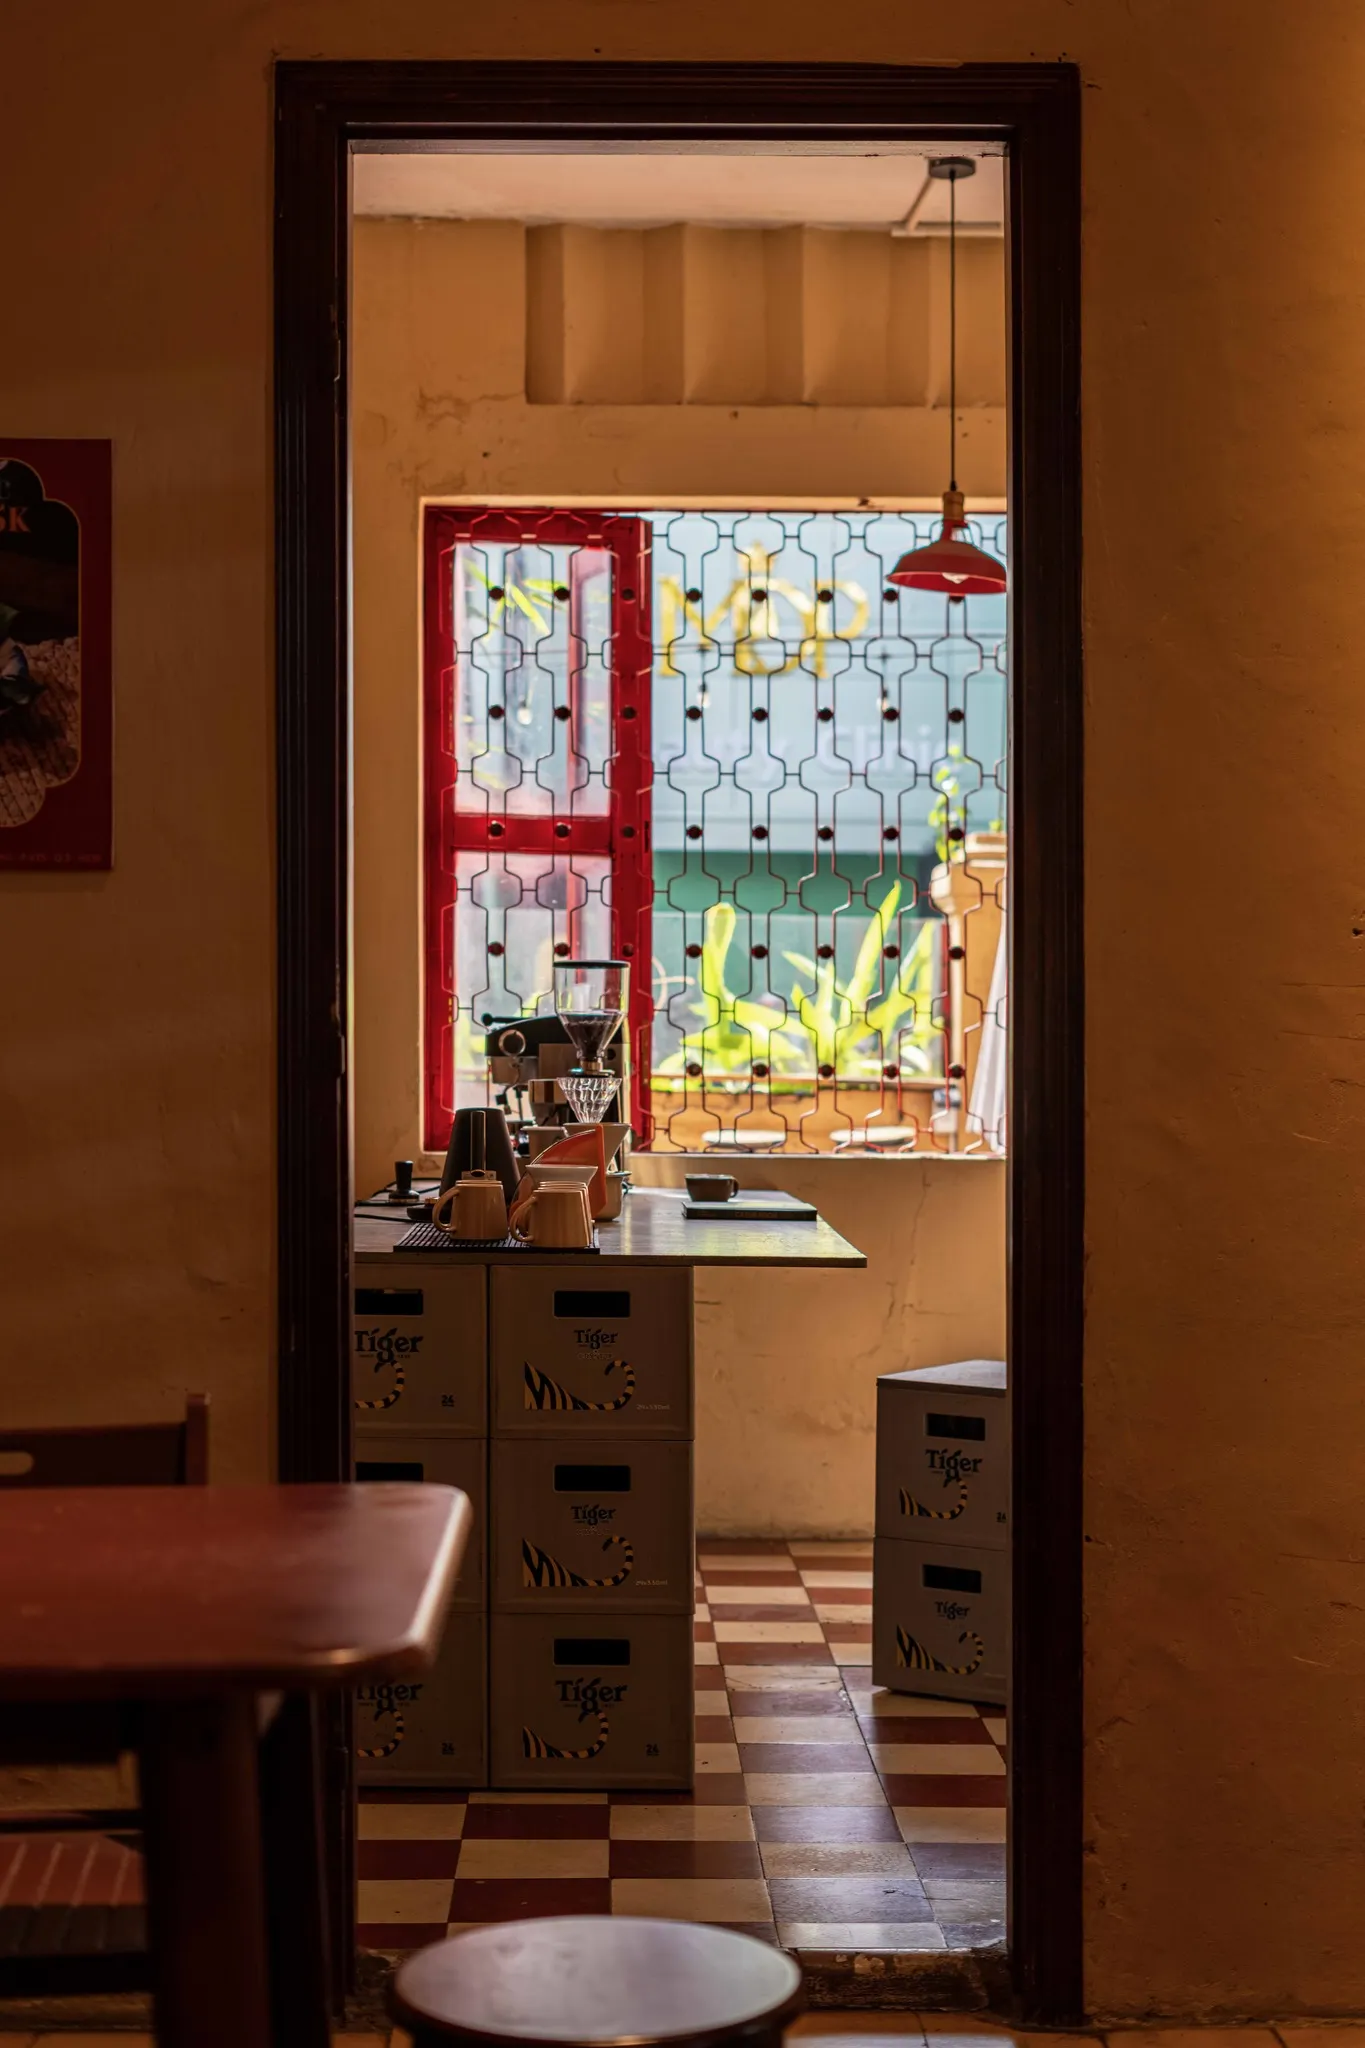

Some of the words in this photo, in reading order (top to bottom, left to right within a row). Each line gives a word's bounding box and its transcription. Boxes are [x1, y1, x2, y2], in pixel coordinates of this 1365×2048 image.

[355, 1328, 424, 1365] Tiger
[573, 1328, 618, 1350] Tiger
[925, 1448, 983, 1481] Tiger
[571, 1504, 616, 1526] Tiger
[934, 1600, 971, 1621] Tiger
[555, 1676, 628, 1715] Tiger
